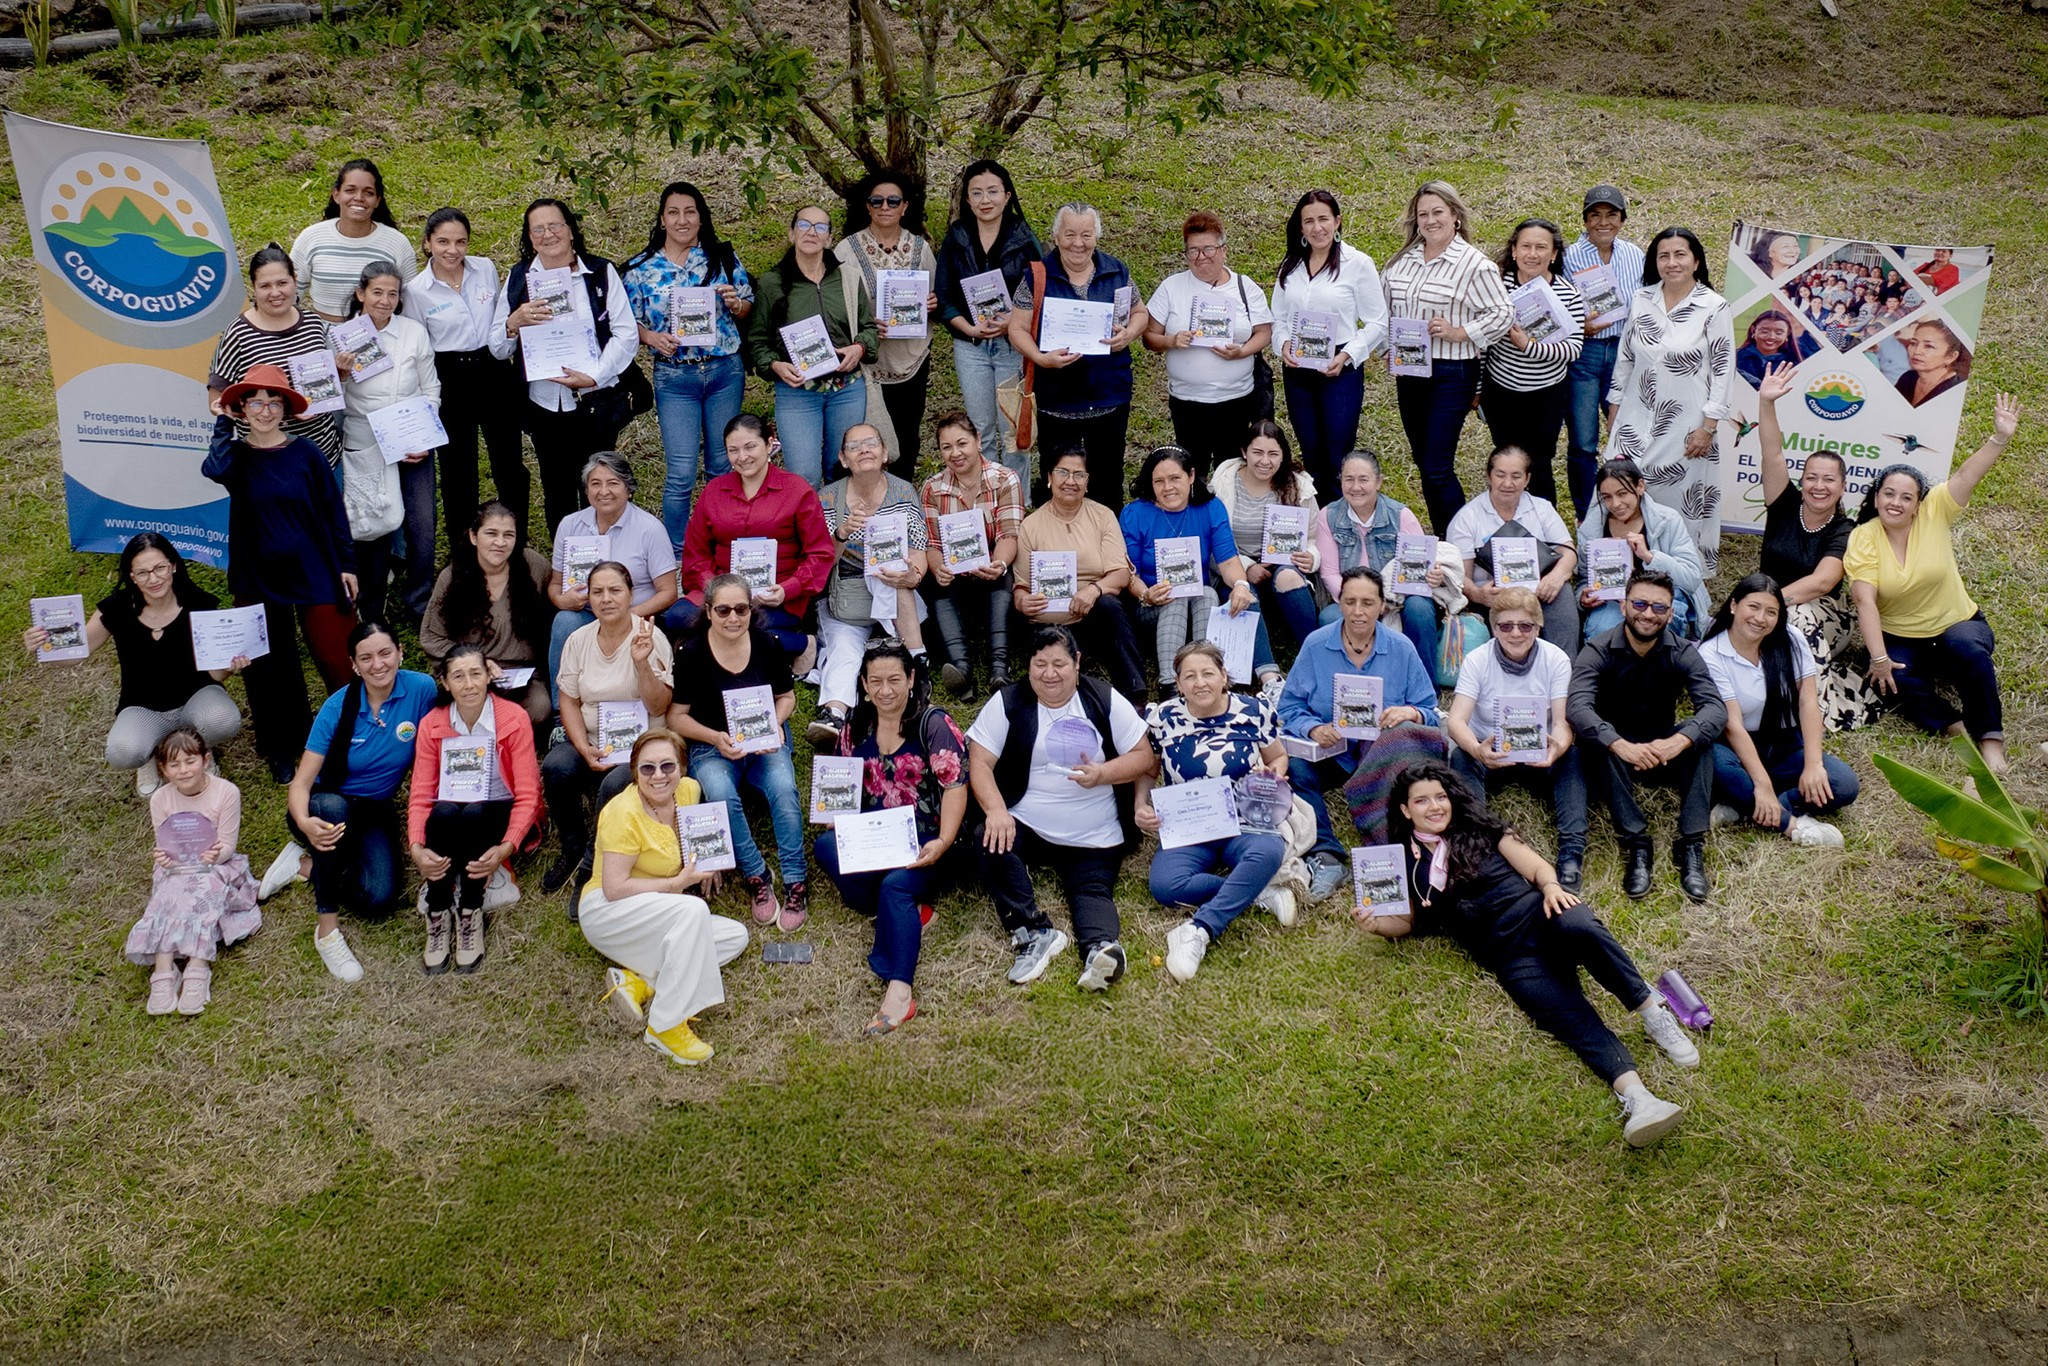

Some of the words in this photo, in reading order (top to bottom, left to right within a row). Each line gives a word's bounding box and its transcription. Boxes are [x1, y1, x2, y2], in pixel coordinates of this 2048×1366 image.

[65, 251, 215, 312] CORPOGUAVIO
[84, 410, 146, 424] Protegemos
[148, 415, 158, 425] la
[161, 416, 185, 429] vida,
[188, 418, 198, 428] el
[77, 424, 147, 438] biodiversidad
[150, 429, 162, 440] de
[164, 433, 204, 443] nuestro
[1738, 454, 1756, 467] EL
[1737, 471, 1763, 484] PO
